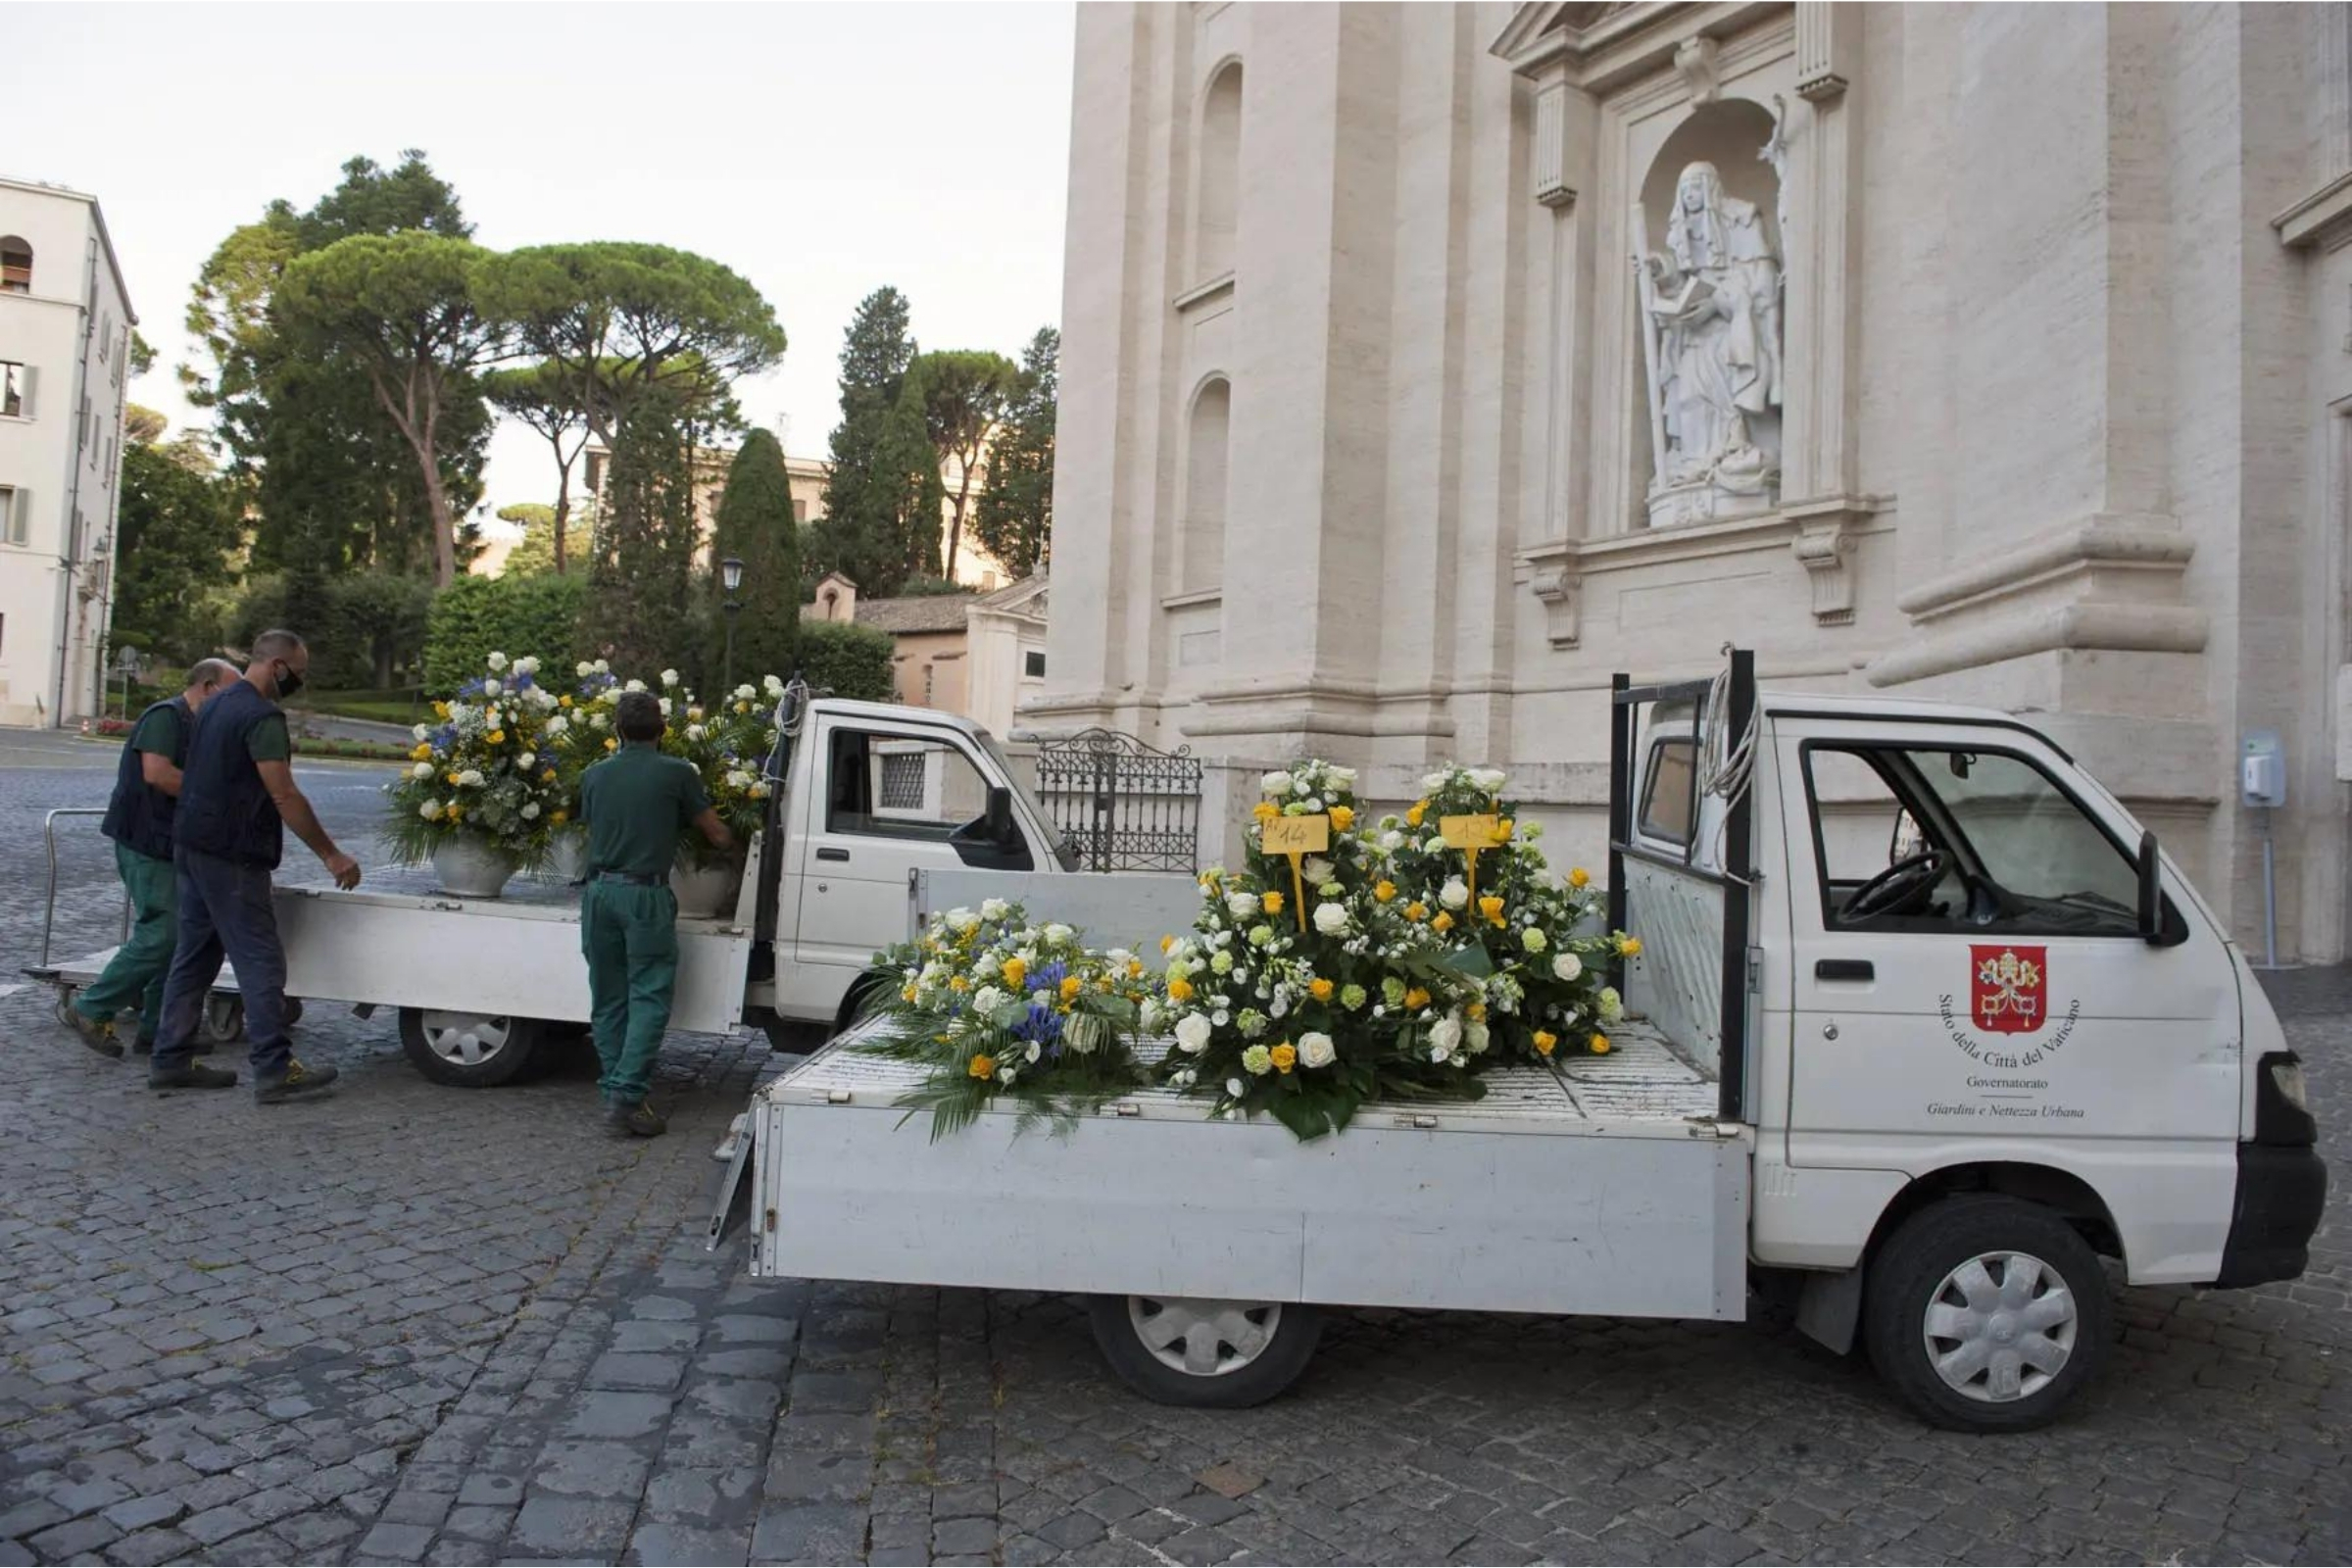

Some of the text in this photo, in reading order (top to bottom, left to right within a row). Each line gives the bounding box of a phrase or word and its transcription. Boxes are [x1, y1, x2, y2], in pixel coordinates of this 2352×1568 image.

[1938, 994, 2081, 1068] Stato della Città del Vaticano
[1966, 1076, 2048, 1090] Governatorato
[1927, 1102, 2084, 1118] Giardini e Nettezza Urbana
